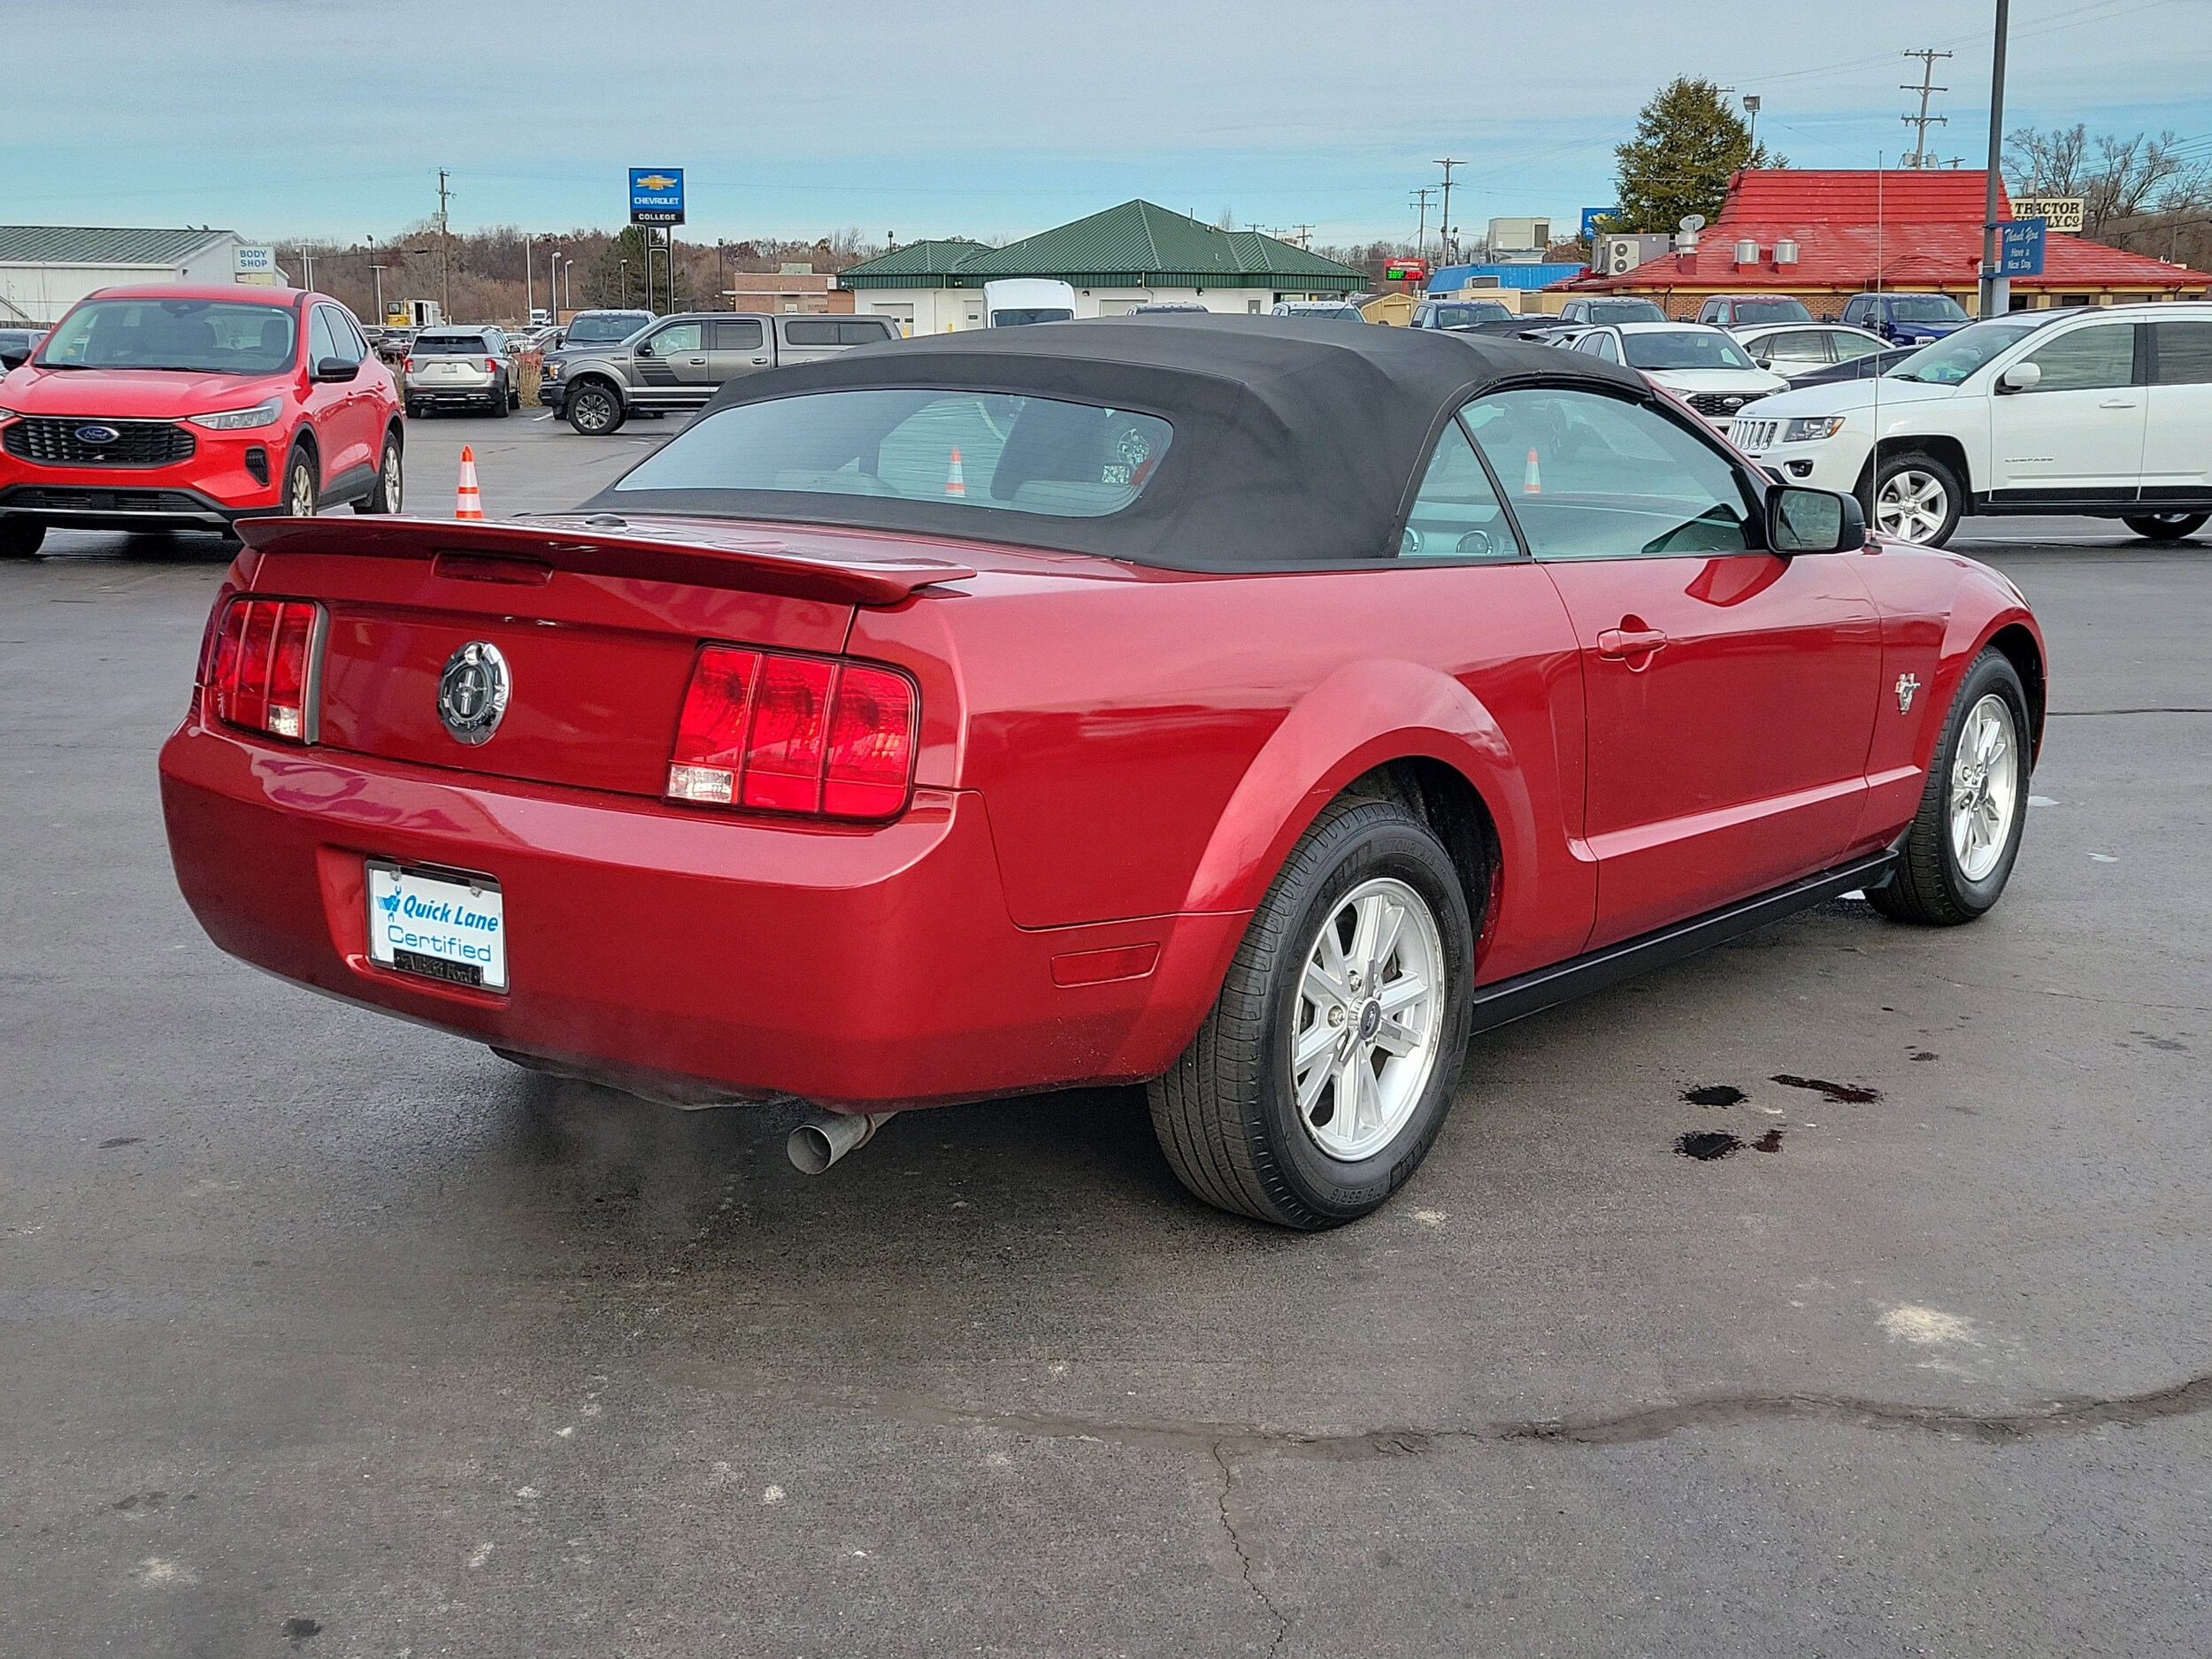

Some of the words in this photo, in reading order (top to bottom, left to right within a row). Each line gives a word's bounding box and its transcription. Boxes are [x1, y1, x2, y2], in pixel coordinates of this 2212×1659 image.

[634, 196, 680, 205] CHEVROLET
[2015, 202, 2080, 215] TRACTOR
[2004, 227, 2024, 243] Thank
[240, 250, 267, 258] BODY
[403, 895, 453, 923] Quick
[453, 906, 499, 932] Lane
[388, 925, 492, 963] Certified
